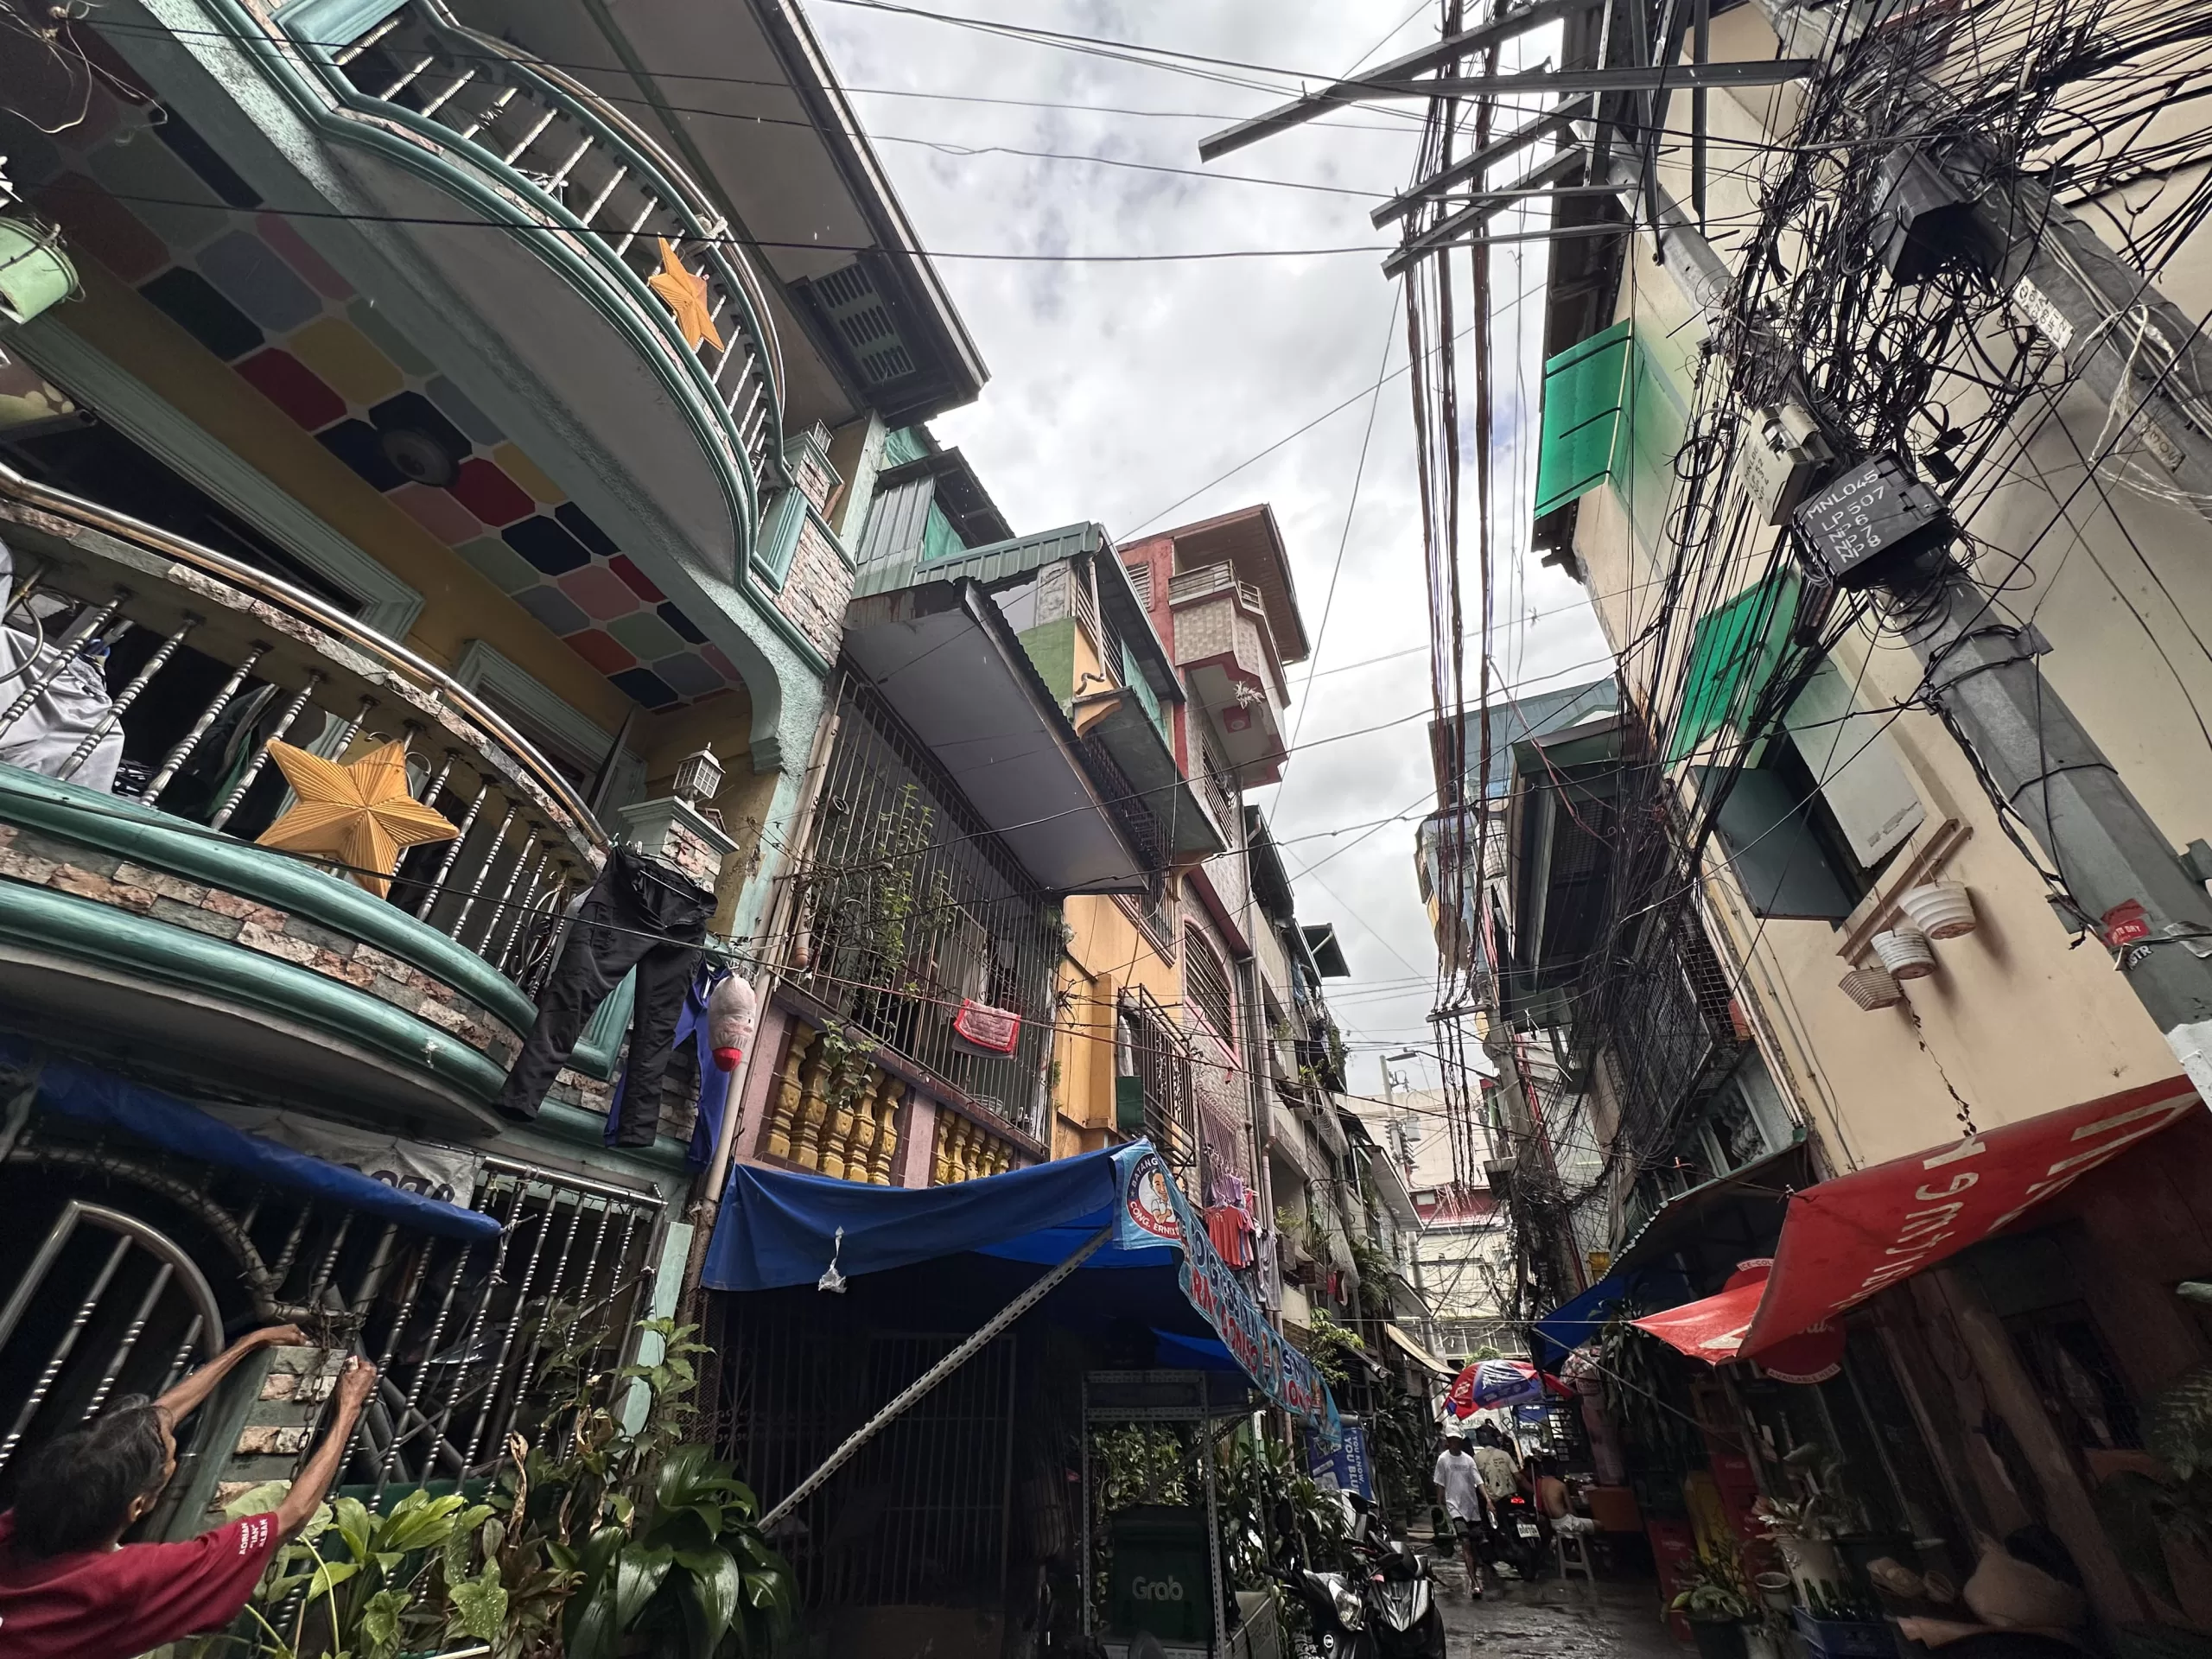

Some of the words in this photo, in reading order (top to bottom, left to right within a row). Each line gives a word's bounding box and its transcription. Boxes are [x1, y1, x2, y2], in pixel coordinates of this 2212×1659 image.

[1807, 469, 1879, 519] MNL045
[1821, 511, 1844, 531] LP
[1848, 486, 1885, 515] 507
[1828, 523, 1852, 543] NP
[1855, 513, 1870, 526] 6
[1834, 534, 1857, 555] NP
[1861, 525, 1874, 539] 7
[1840, 543, 1865, 563] NP
[1869, 535, 1882, 548] 8
[1132, 1158, 1159, 1188] BATANG
[1130, 1201, 1151, 1228] CONG.
[1739, 1259, 1774, 1270] ICE-COL
[1768, 1368, 1815, 1382] AVAILABLE
[1818, 1363, 1839, 1380] HERE
[1344, 1437, 1356, 1463] YOU
[1132, 1574, 1184, 1601] Grab
